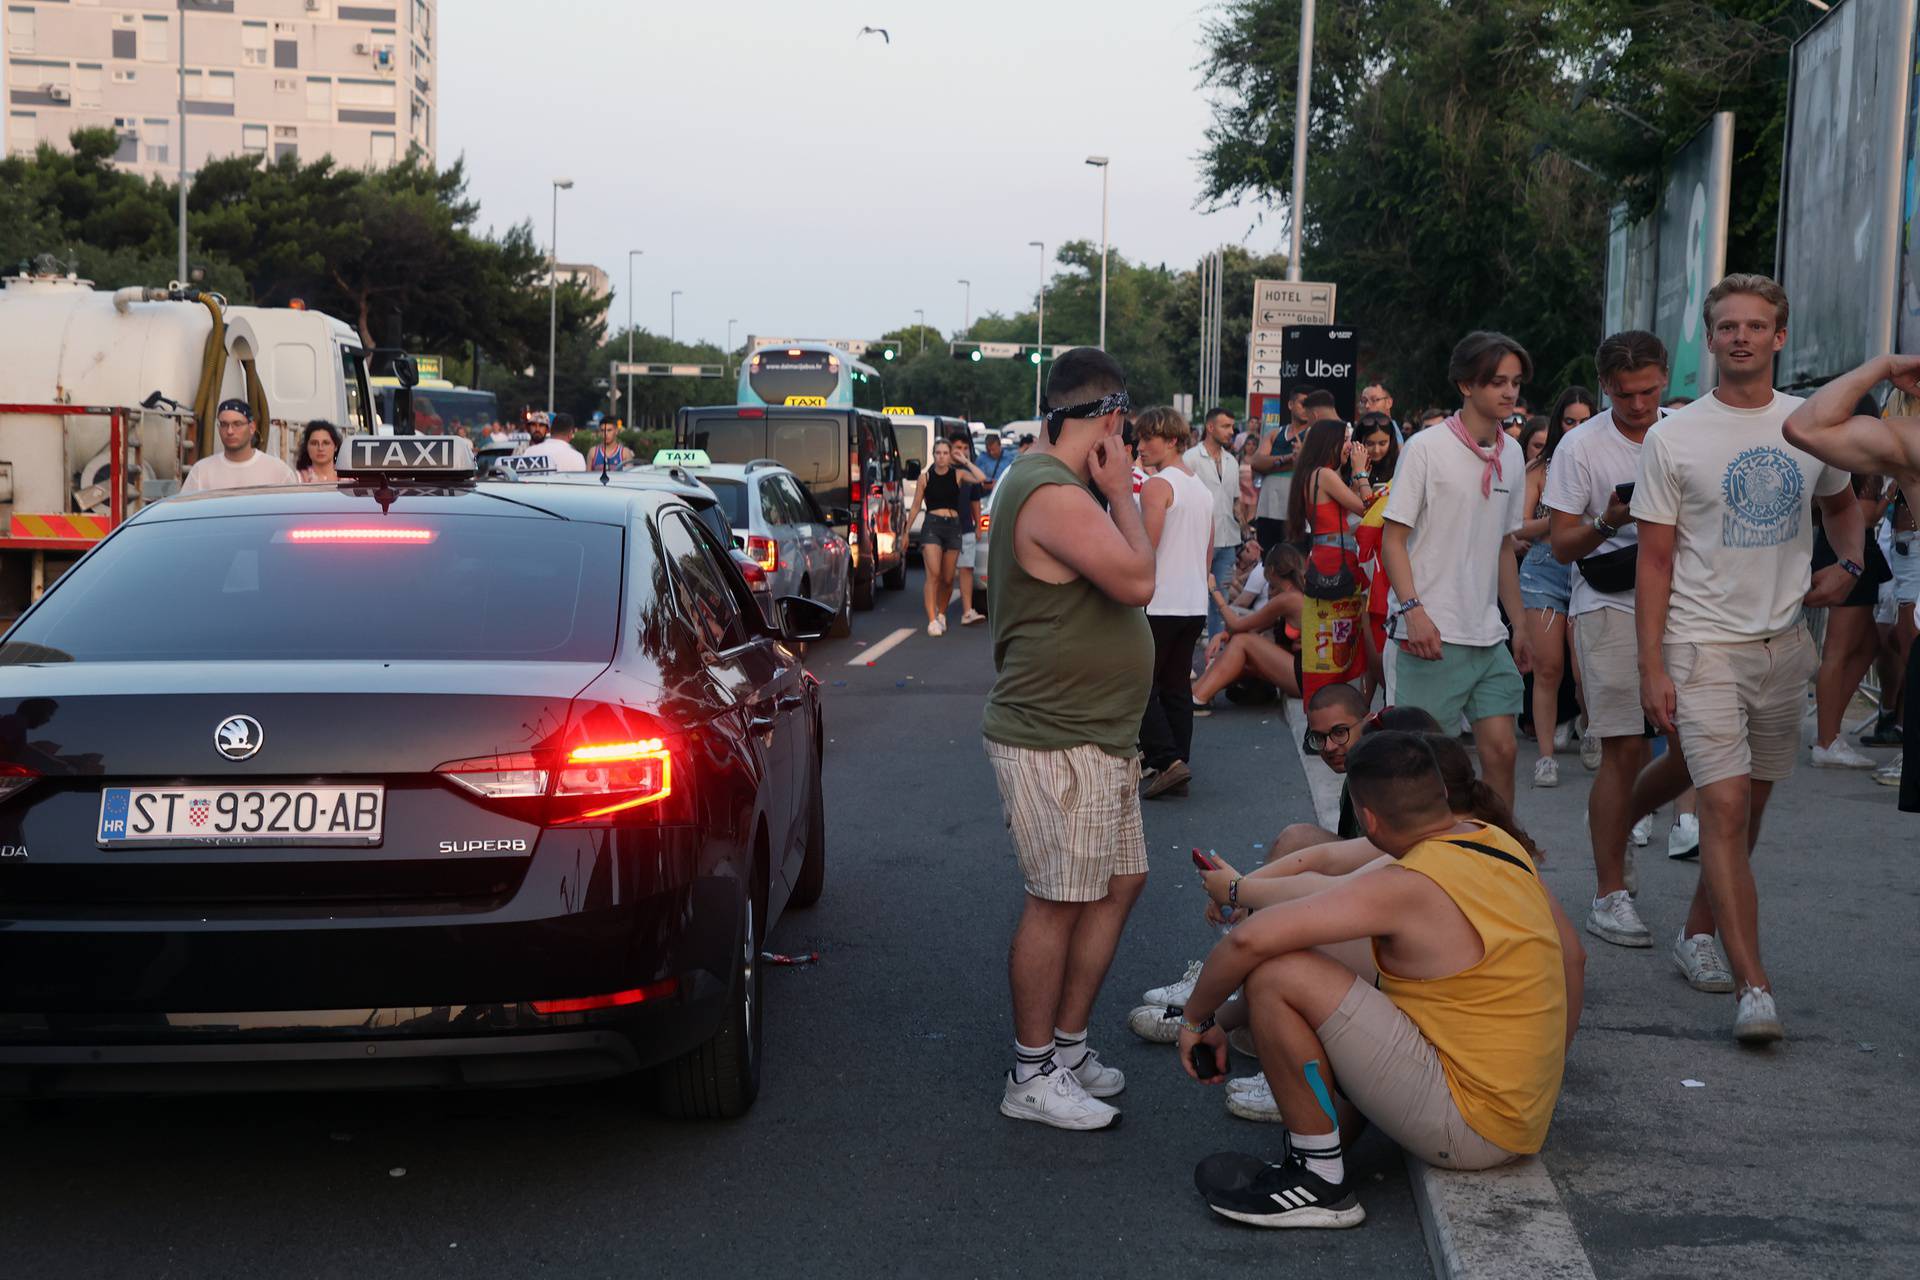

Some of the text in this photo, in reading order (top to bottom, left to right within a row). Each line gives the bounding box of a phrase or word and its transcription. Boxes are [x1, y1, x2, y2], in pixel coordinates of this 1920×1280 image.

[1265, 290, 1301, 302] HOTEL
[1305, 359, 1351, 378] Uber
[790, 398, 822, 406] TAXI
[357, 441, 449, 467] TAXI
[502, 456, 546, 470] TAXI
[132, 793, 184, 833] ST
[104, 819, 125, 832] HR
[0, 845, 29, 857] DA
[439, 839, 527, 853] SUPERB
